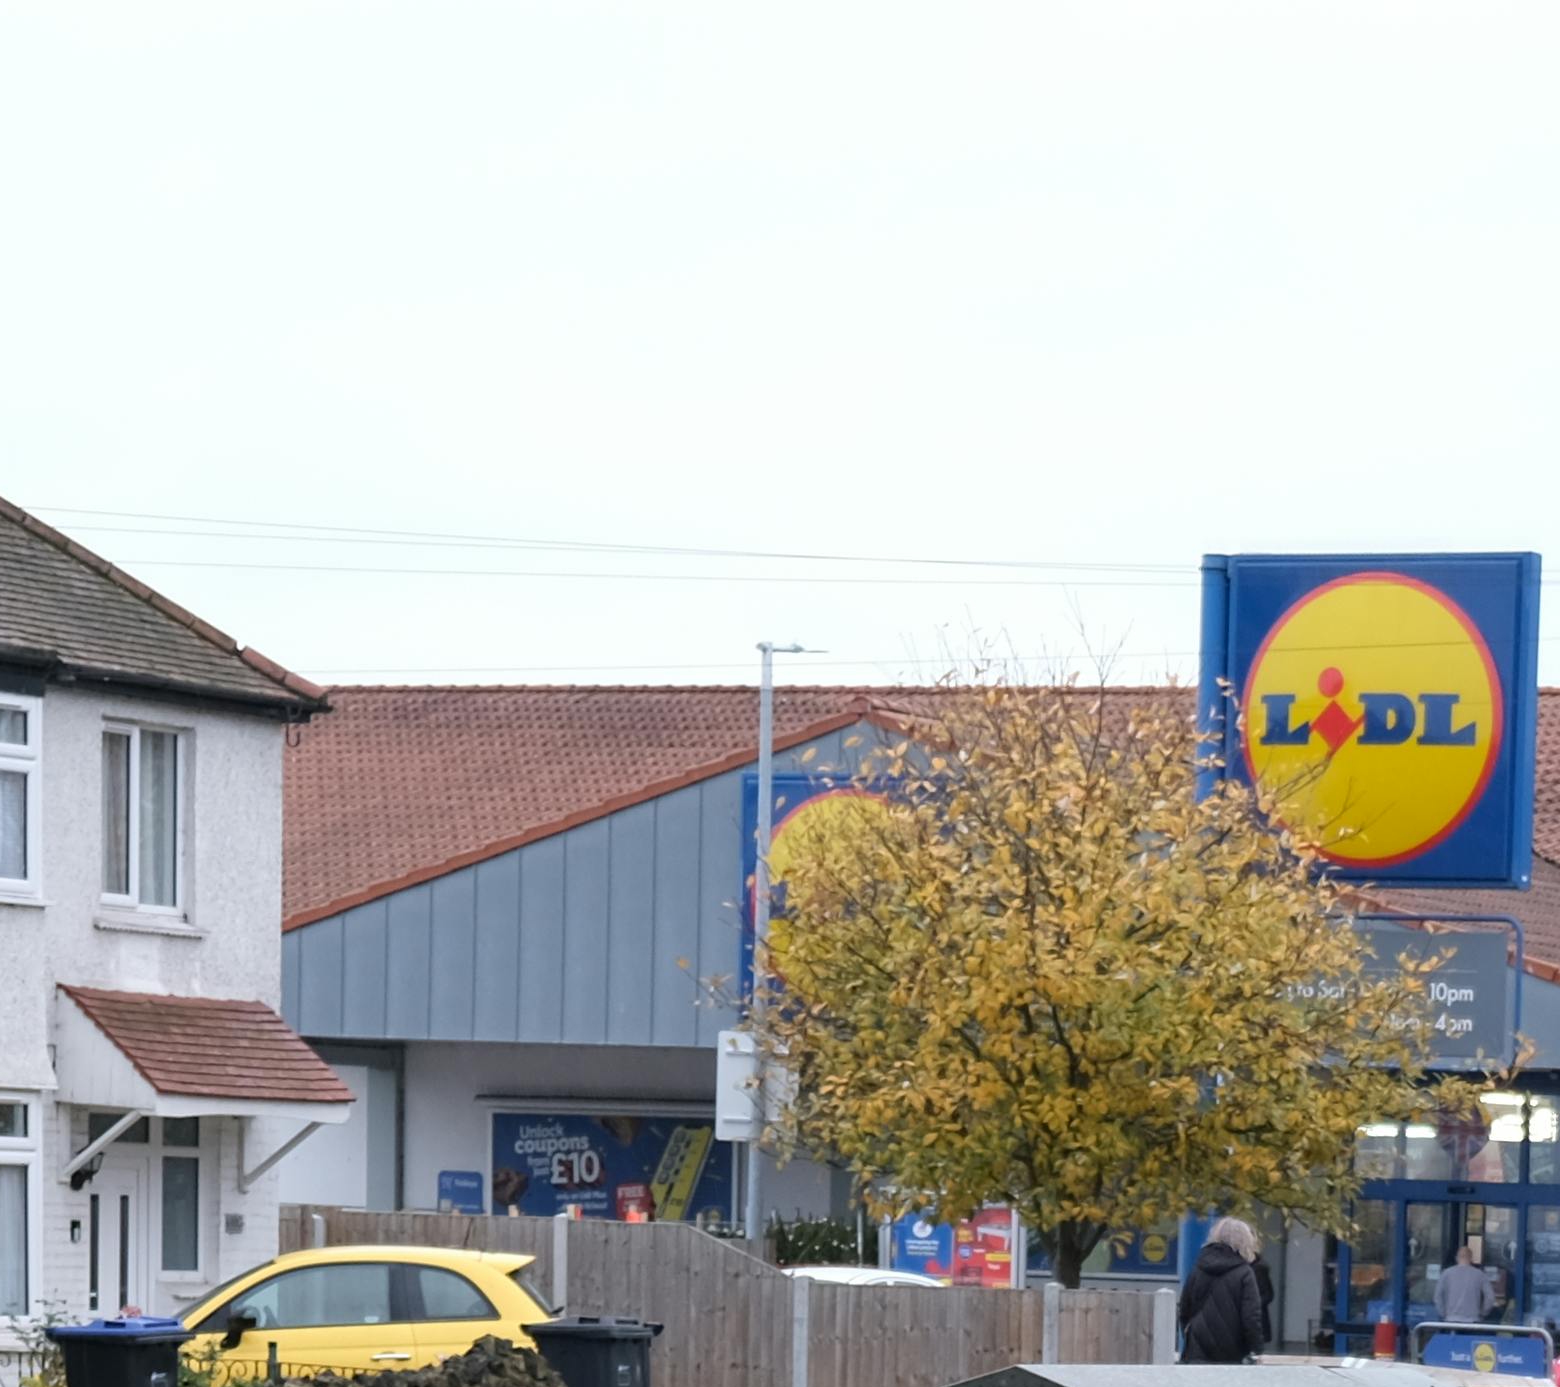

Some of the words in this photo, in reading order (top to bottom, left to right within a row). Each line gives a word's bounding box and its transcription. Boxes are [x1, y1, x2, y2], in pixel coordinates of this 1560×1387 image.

[1259, 667, 1477, 751] LIDL
[1429, 982, 1474, 1007] 10pm
[519, 1122, 564, 1139] Unlock
[514, 1136, 590, 1157] coupons
[550, 1150, 600, 1185] £10
